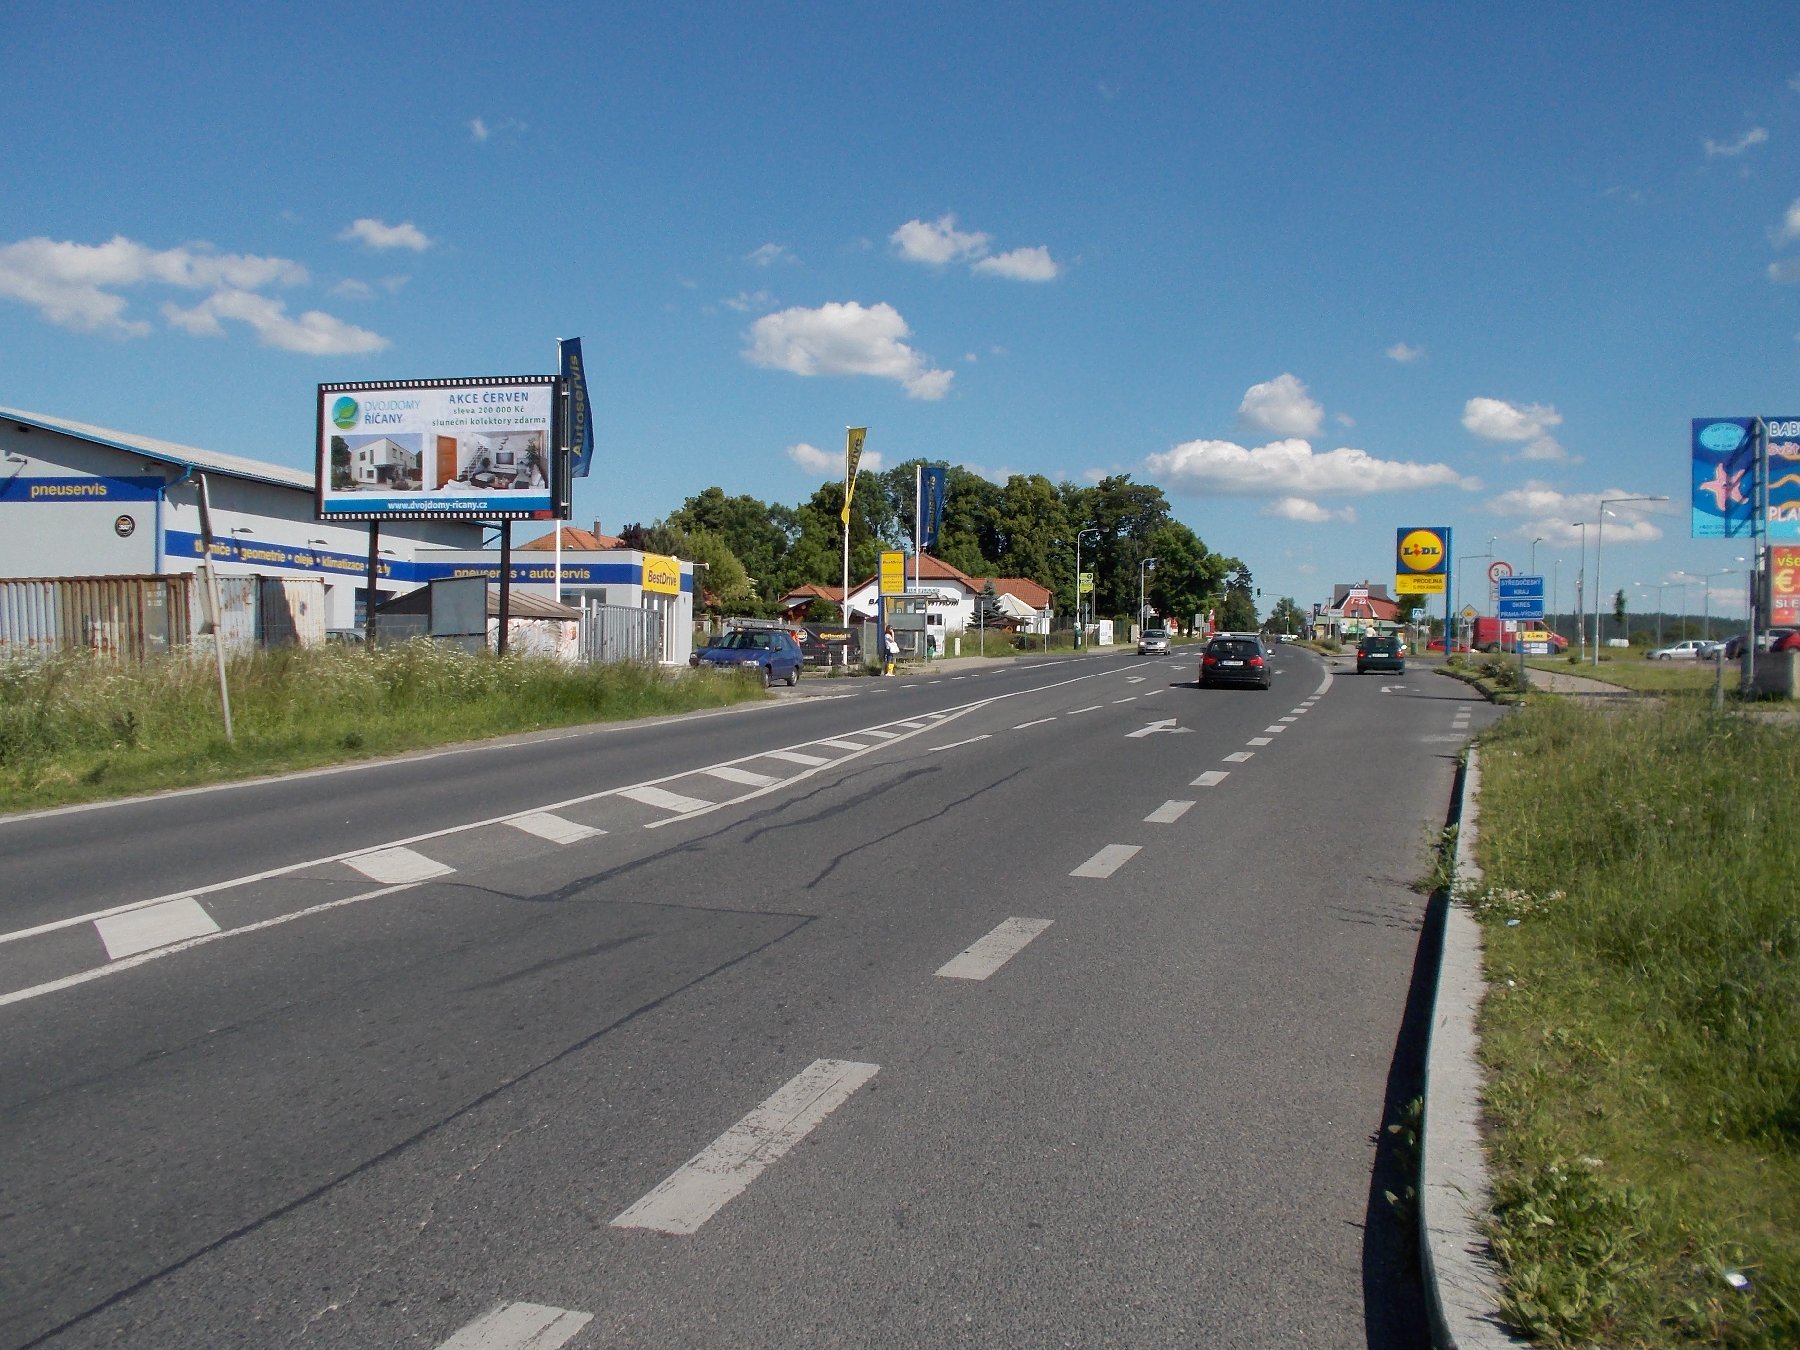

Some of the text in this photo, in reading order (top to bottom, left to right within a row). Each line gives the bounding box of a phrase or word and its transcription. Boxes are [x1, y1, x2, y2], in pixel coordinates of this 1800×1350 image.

[449, 393, 479, 404] AKCE
[364, 400, 421, 412] DVOJDOMY
[453, 407, 475, 415] sleva
[514, 405, 525, 413] Kč
[570, 355, 585, 457] Autoservis
[364, 413, 403, 425] ŘÍČANY
[432, 416, 546, 427] sluneční kolektory zdarma
[1770, 421, 1800, 436] BAB
[1767, 441, 1800, 456] Svět
[31, 482, 107, 498] pneuservis
[387, 499, 488, 511] www.dvojdomy-ricany.cz
[1768, 506, 1800, 521] PLA
[193, 540, 231, 556] tlmiče
[240, 546, 286, 563] geometrie
[294, 553, 313, 567] oleje
[321, 555, 364, 571] klimatizace
[1403, 544, 1441, 556] LIDL
[454, 569, 517, 579] pneusers
[647, 571, 677, 587] BestDrive
